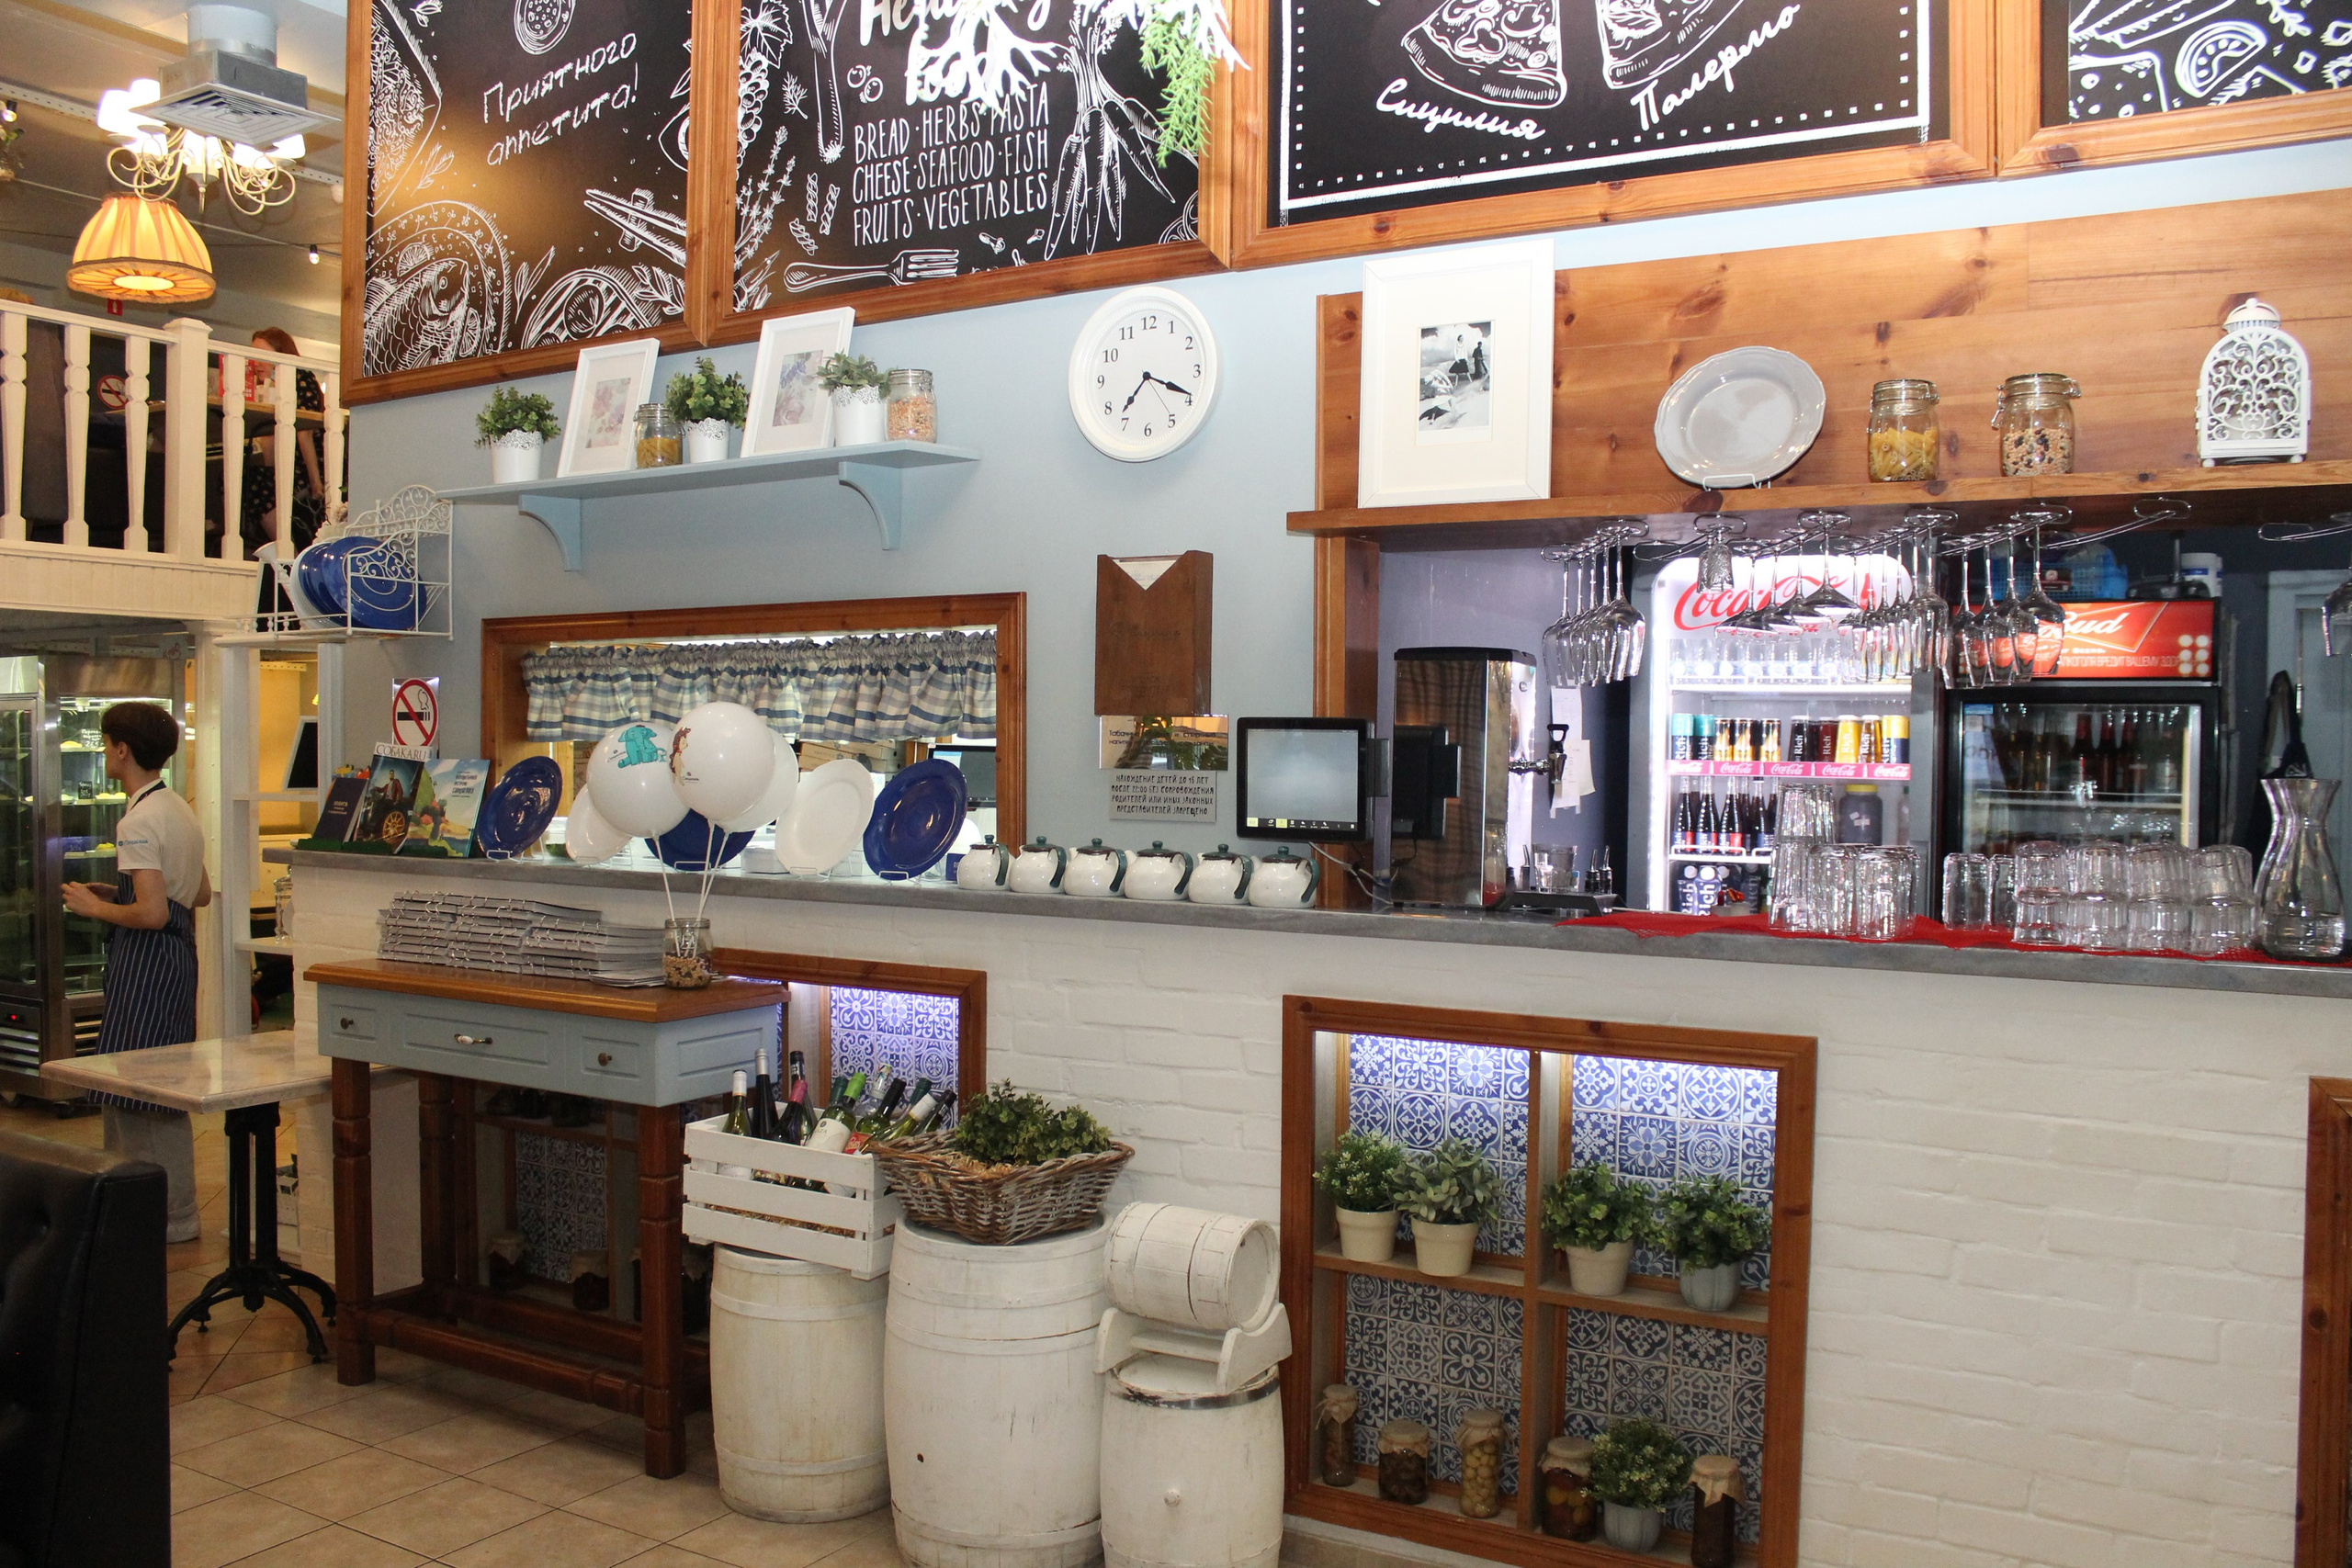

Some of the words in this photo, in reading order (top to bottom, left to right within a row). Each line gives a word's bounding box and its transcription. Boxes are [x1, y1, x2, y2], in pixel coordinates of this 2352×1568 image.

[1630, 4, 1801, 130] Палермо
[483, 33, 637, 123] Приятного
[487, 62, 639, 166] аппетита!
[1376, 77, 1546, 141] Сицилия
[854, 118, 910, 164] BREAD
[922, 101, 980, 148] HERBS
[990, 81, 1049, 136] PASTA
[853, 156, 910, 204] CHEESE
[917, 140, 994, 190] SEAFOOD
[1004, 129, 1048, 176] FISH
[854, 197, 914, 246] FRUITS
[923, 172, 1047, 231] VEGETABLES
[1141, 315, 1157, 331] 12
[1168, 321, 1175, 334] 1
[1119, 326, 1134, 341] 11
[1185, 336, 1193, 350] 2
[1102, 348, 1119, 363] 10
[1193, 364, 1201, 378] 3
[1097, 375, 1105, 389] 9
[1184, 394, 1193, 406] 4
[1104, 401, 1113, 415] 8
[1121, 417, 1129, 432] 7
[1168, 413, 1176, 428] 5
[1144, 423, 1152, 436] 6
[1116, 774, 1155, 784] НАХОЖДЕНИЕ
[1157, 774, 1177, 784] ДЕТЕЙ
[1179, 776, 1186, 784] ДО
[1196, 776, 1209, 784] ЛЕТ
[1112, 784, 1130, 793] ПОСЛЕ
[1148, 785, 1159, 794] БЕЗ
[1160, 785, 1215, 795] СОПРОВОЖДЕНИЯ
[1112, 794, 1147, 803] РОДИТЕЛЕЙ
[1148, 795, 1161, 804] ИЛИ
[1182, 796, 1214, 805] ЗАКОННЫХ
[1116, 805, 1170, 814] ПРЕДСТАВИТЕЛЕЙ
[1172, 806, 1208, 817] ЗАПРЕЩЕНО
